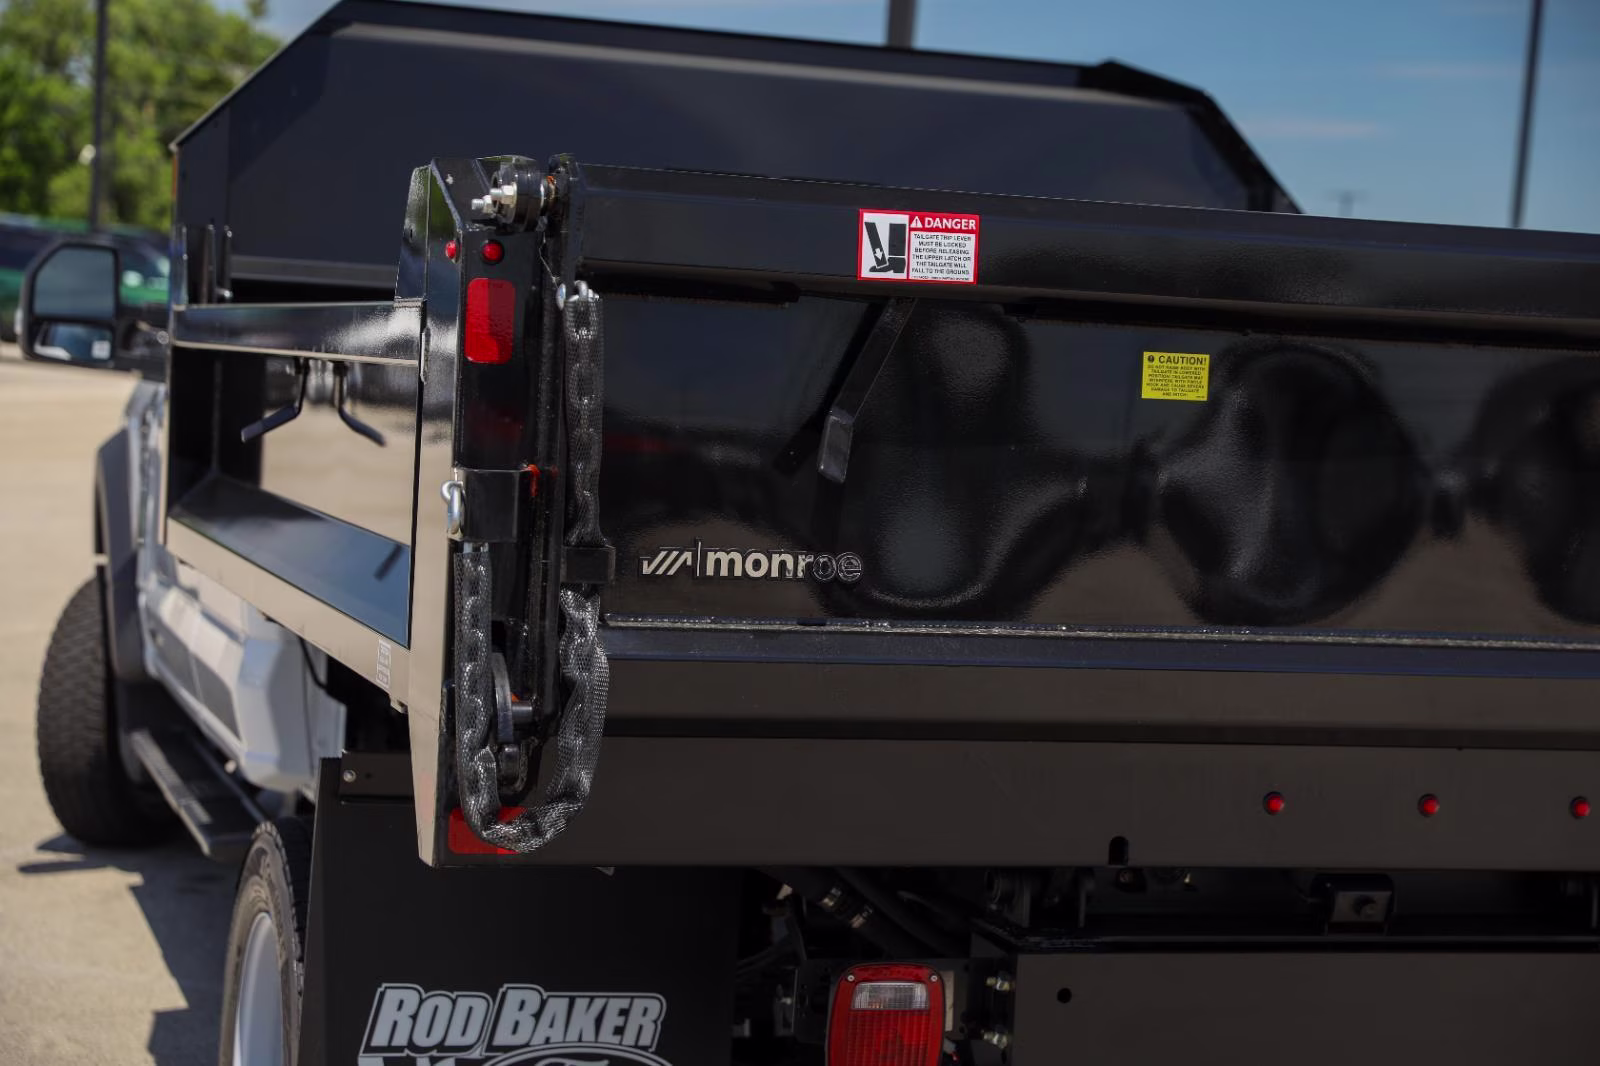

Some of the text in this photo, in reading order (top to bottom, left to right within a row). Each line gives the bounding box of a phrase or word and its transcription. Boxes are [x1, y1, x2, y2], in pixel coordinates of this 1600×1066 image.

[924, 217, 977, 230] DANGER
[914, 233, 940, 241] TAILGATE
[1158, 355, 1207, 365] CAUTION!
[705, 549, 863, 582] monroe
[368, 986, 663, 1048] ROD BAKER
